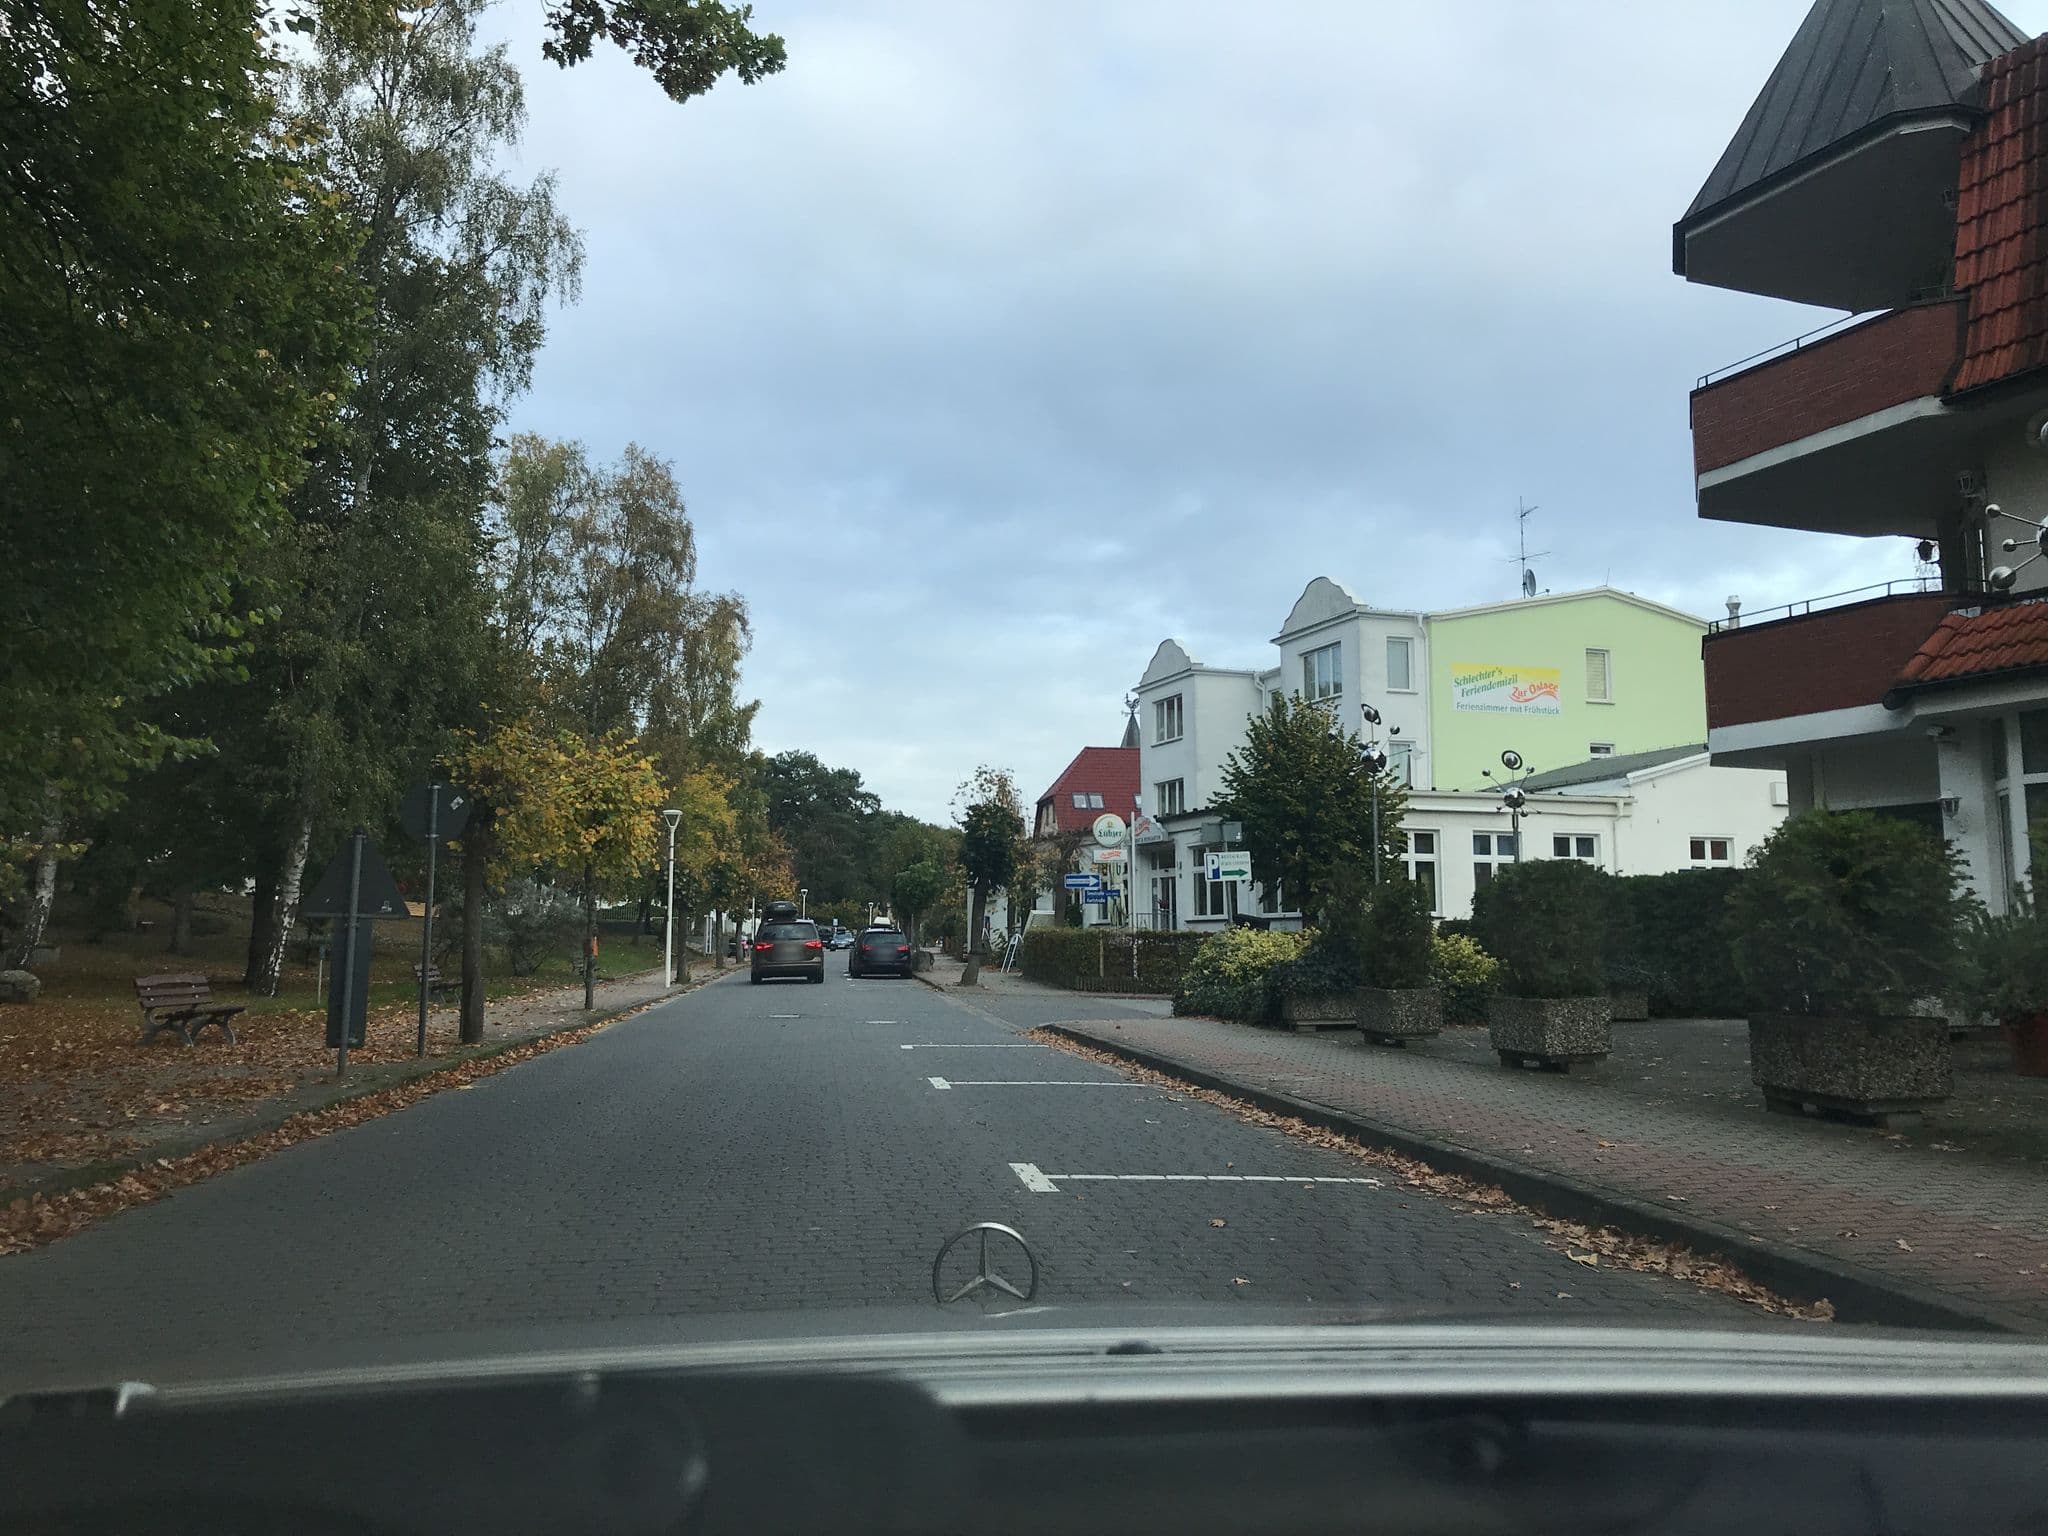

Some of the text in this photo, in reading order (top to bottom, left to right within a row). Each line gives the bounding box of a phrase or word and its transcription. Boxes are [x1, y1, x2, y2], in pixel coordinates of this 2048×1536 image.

[1454, 667, 1502, 688] Schlechter's
[1461, 674, 1518, 697] Feriendomizil
[1512, 682, 1558, 699] Zur Ostsee
[1456, 702, 1559, 715] Ferienzimmer mit Frühstück
[1207, 855, 1218, 878] P
